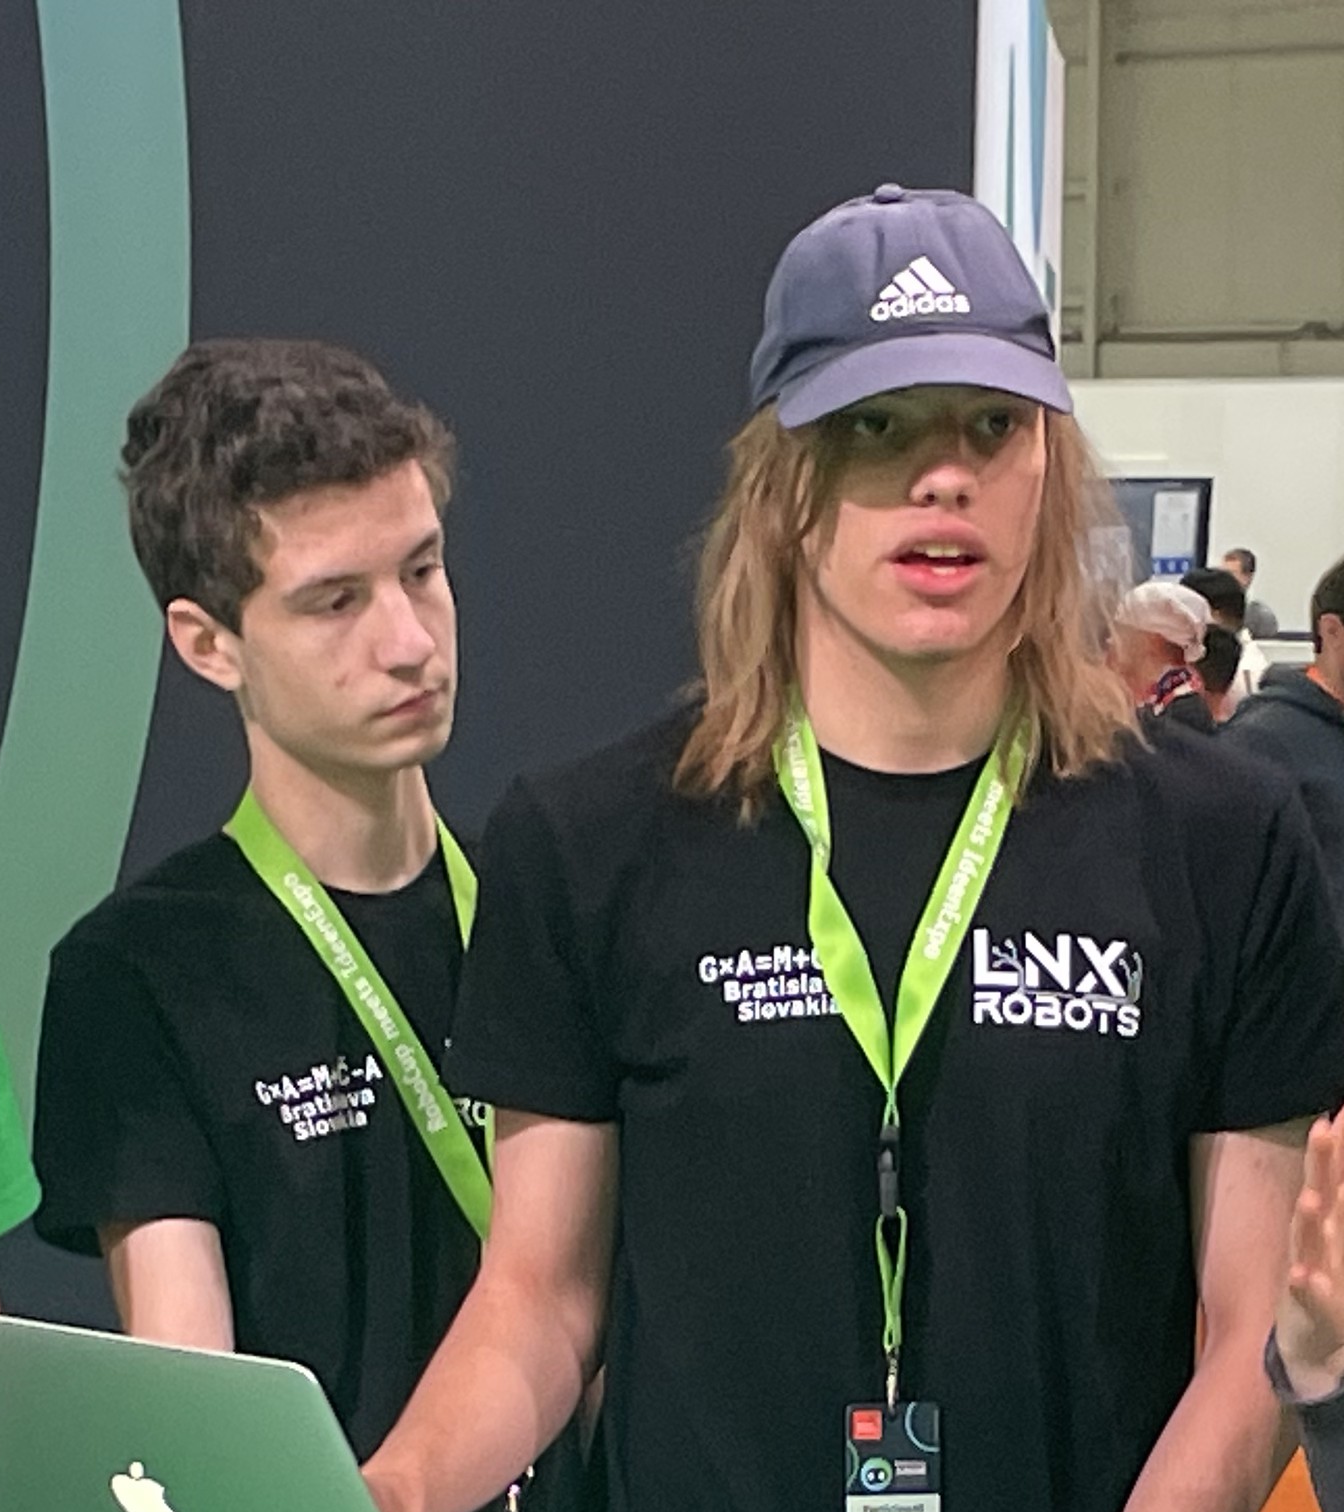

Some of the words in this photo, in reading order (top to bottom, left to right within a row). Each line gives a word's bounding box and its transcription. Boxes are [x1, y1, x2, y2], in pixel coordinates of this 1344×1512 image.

[355, 976, 400, 1040] meets
[723, 974, 824, 1002] Bratisla
[973, 991, 1141, 1037] ROBOTS
[395, 1043, 448, 1133] RoboCup
